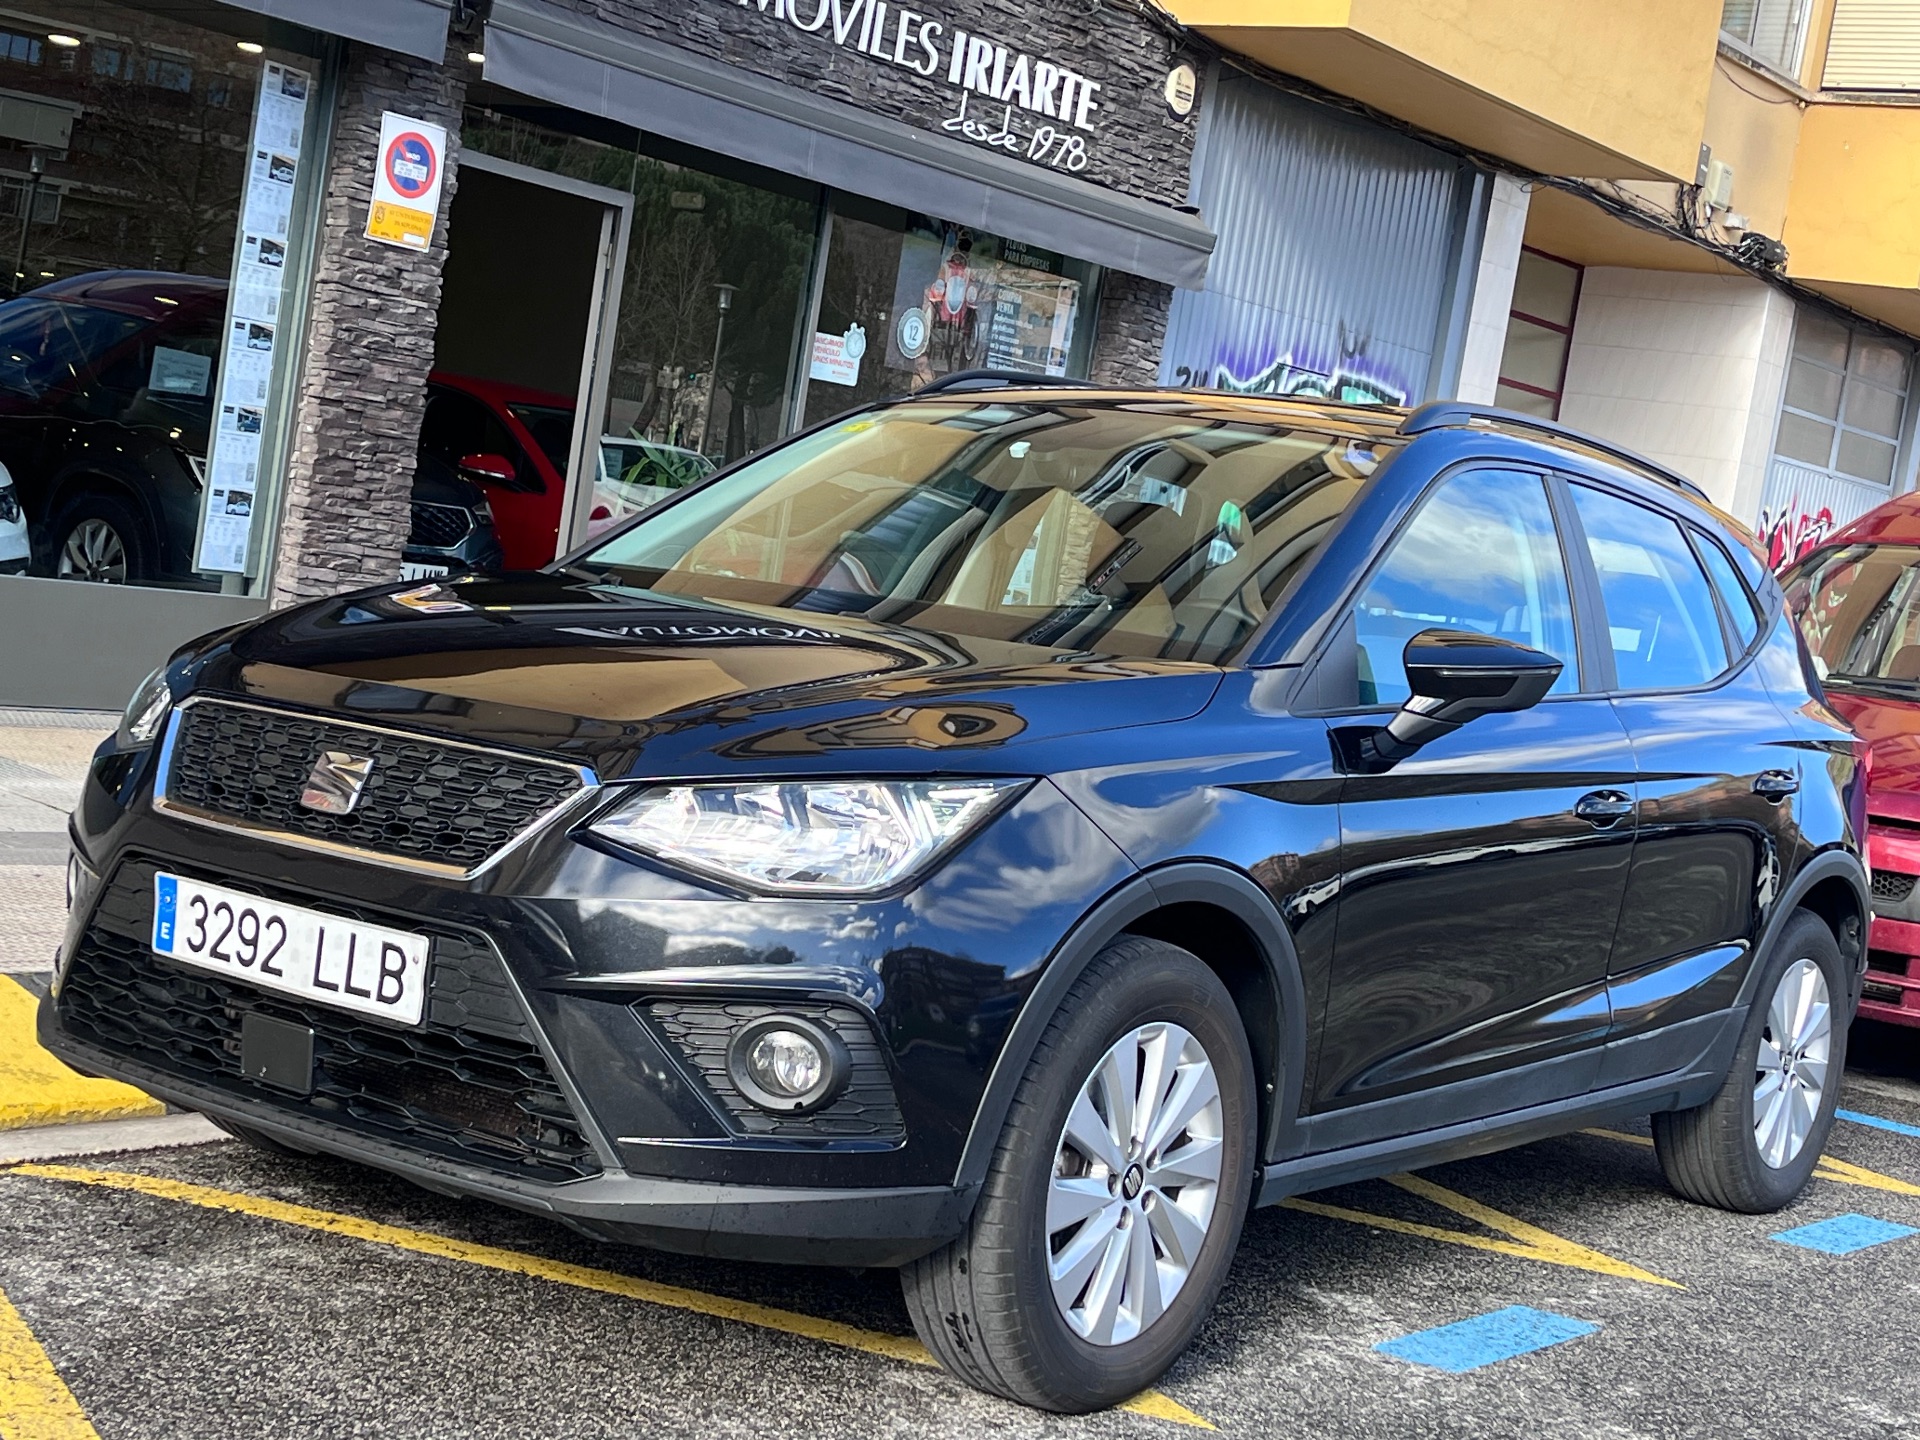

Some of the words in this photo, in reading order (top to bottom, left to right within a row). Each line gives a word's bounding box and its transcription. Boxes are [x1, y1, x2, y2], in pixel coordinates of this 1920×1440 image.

[948, 31, 1101, 132] IRIARTE
[941, 90, 1019, 152] desde
[1027, 126, 1087, 171] 1978
[1020, 253, 1050, 272] EMPRESAS
[996, 301, 1014, 315] VENTA
[909, 324, 919, 341] 12
[160, 921, 171, 939] E
[186, 894, 287, 977] 3292
[313, 926, 407, 1004] LLB
